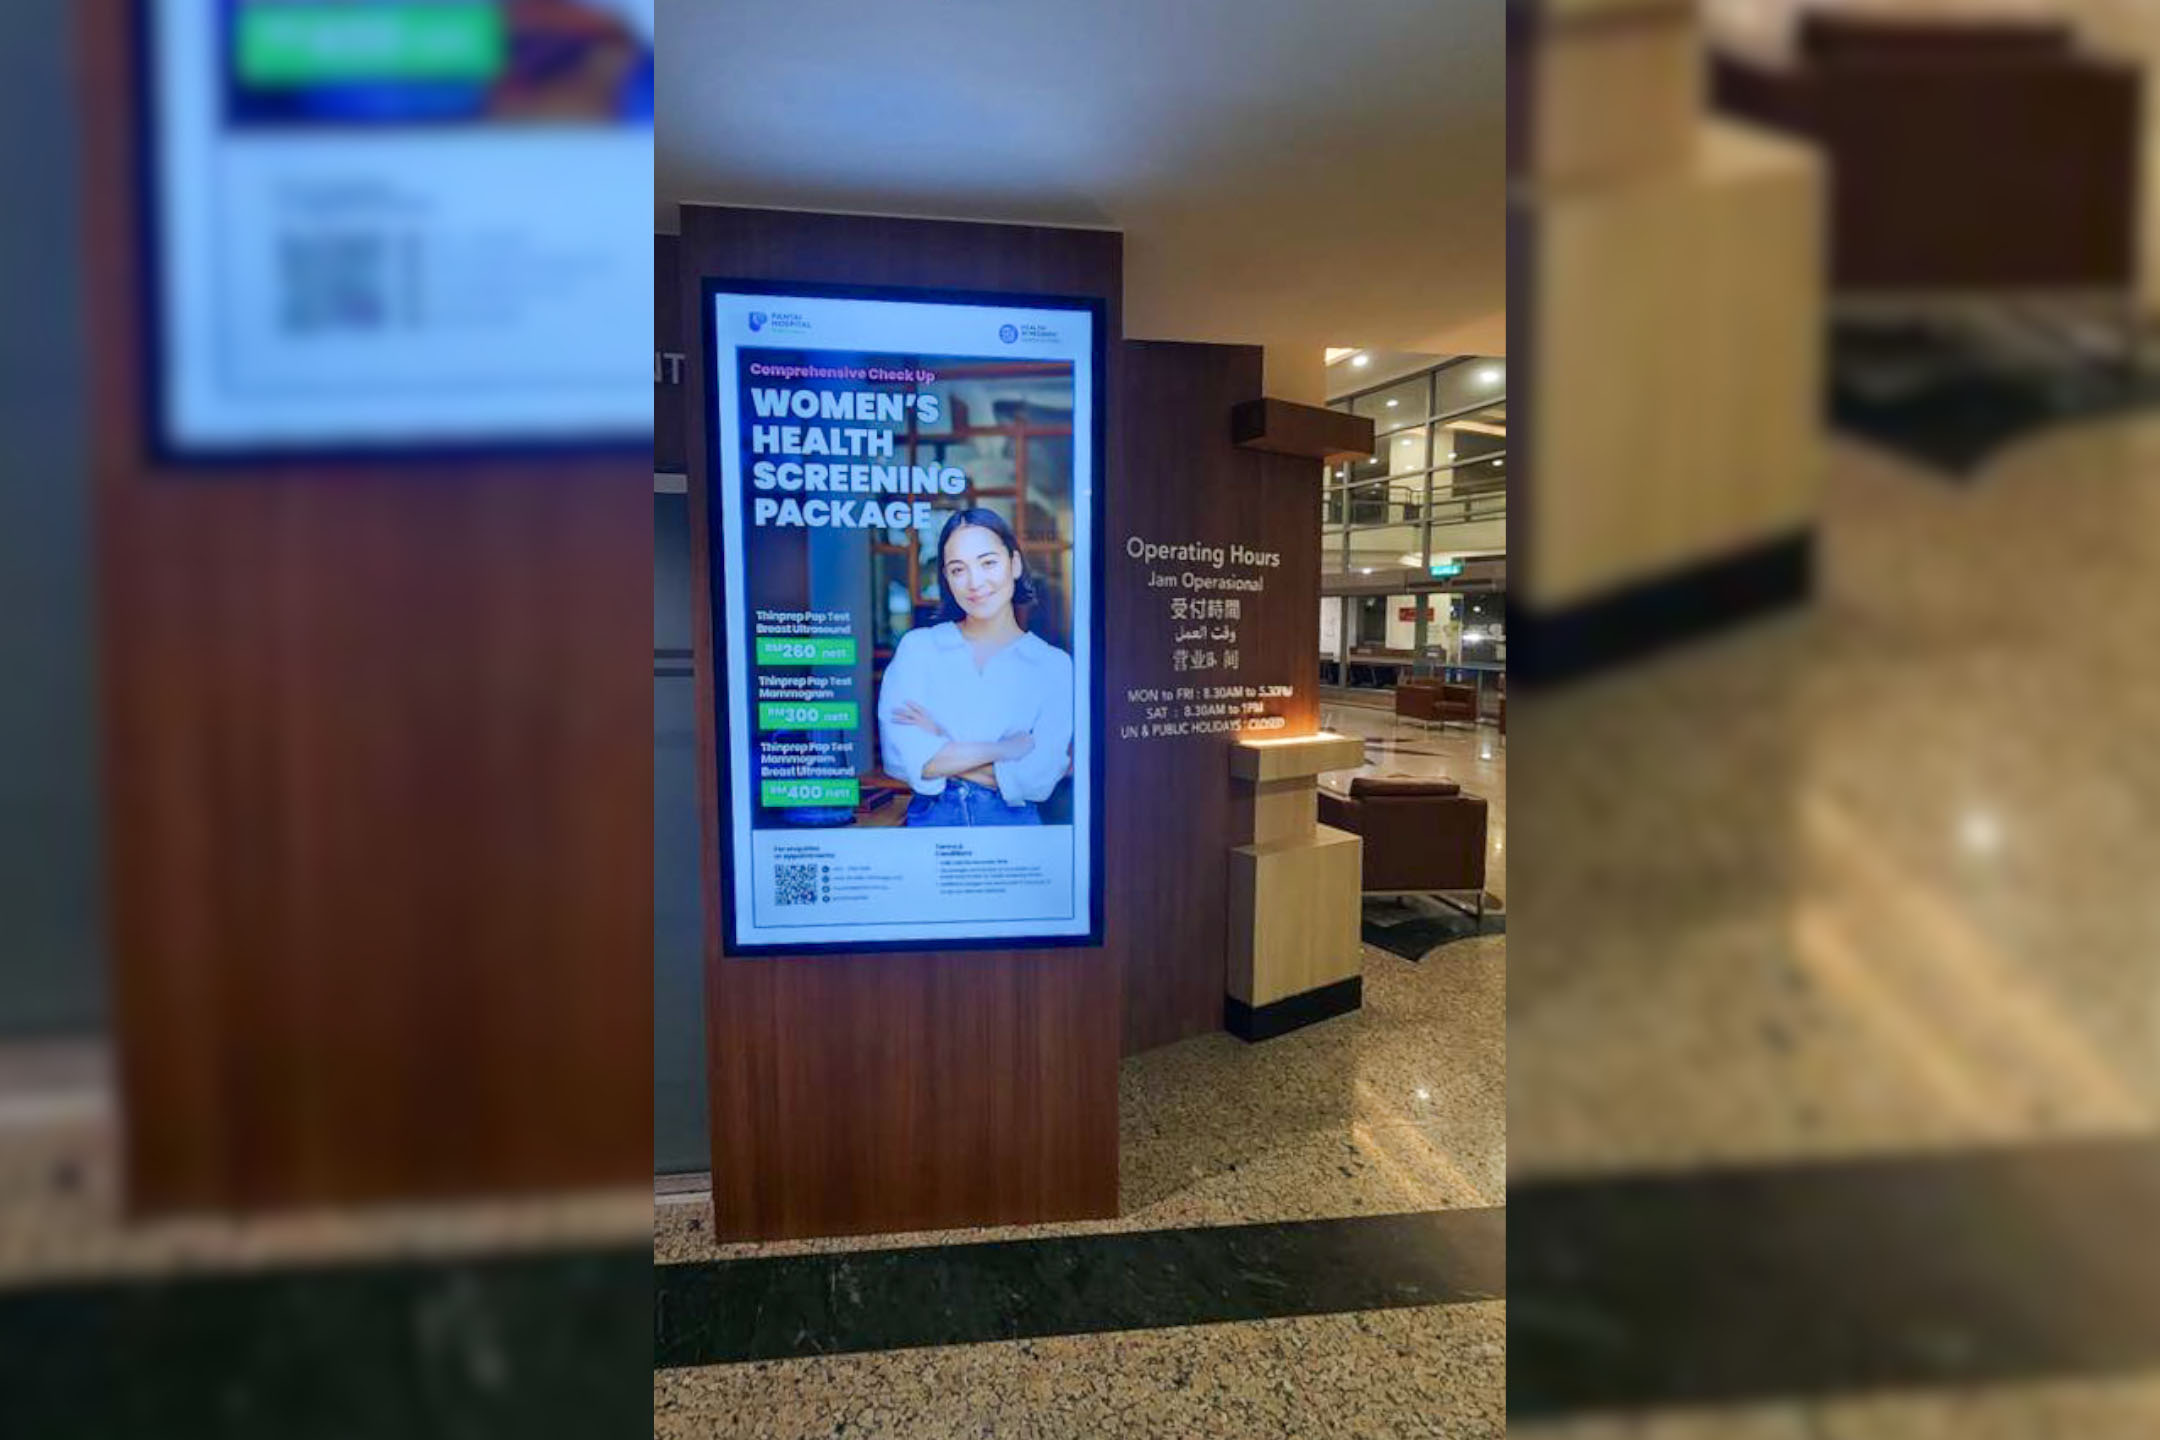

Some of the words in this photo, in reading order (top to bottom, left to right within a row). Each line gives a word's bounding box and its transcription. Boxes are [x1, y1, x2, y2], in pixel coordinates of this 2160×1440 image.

[750, 363, 866, 380] Comprehensive
[868, 368, 914, 382] Check
[916, 370, 936, 384] Up
[750, 387, 940, 424] WOMEN'S
[752, 424, 894, 458] HEALTH
[753, 461, 967, 495] SCREENING
[755, 497, 932, 530] PACKAGE
[1126, 536, 1225, 569] Operating
[1230, 544, 1281, 568] Hours
[1148, 571, 1177, 588] Jam
[1181, 572, 1264, 592] Operasional
[828, 612, 850, 621] Test
[756, 624, 792, 634] Breast
[792, 624, 852, 634] Ultrasound
[1127, 688, 1159, 702] MON
[1161, 690, 1174, 701] to
[1176, 687, 1194, 700] FRI
[1203, 686, 1244, 699] 8.30AM
[1245, 687, 1257, 698] to
[1145, 706, 1168, 720] SAT
[1184, 703, 1226, 718] 8.30AM
[1228, 704, 1240, 714] to
[1151, 722, 1190, 737] PUBLIC
[1191, 718, 1241, 733] HOLIDAYS
